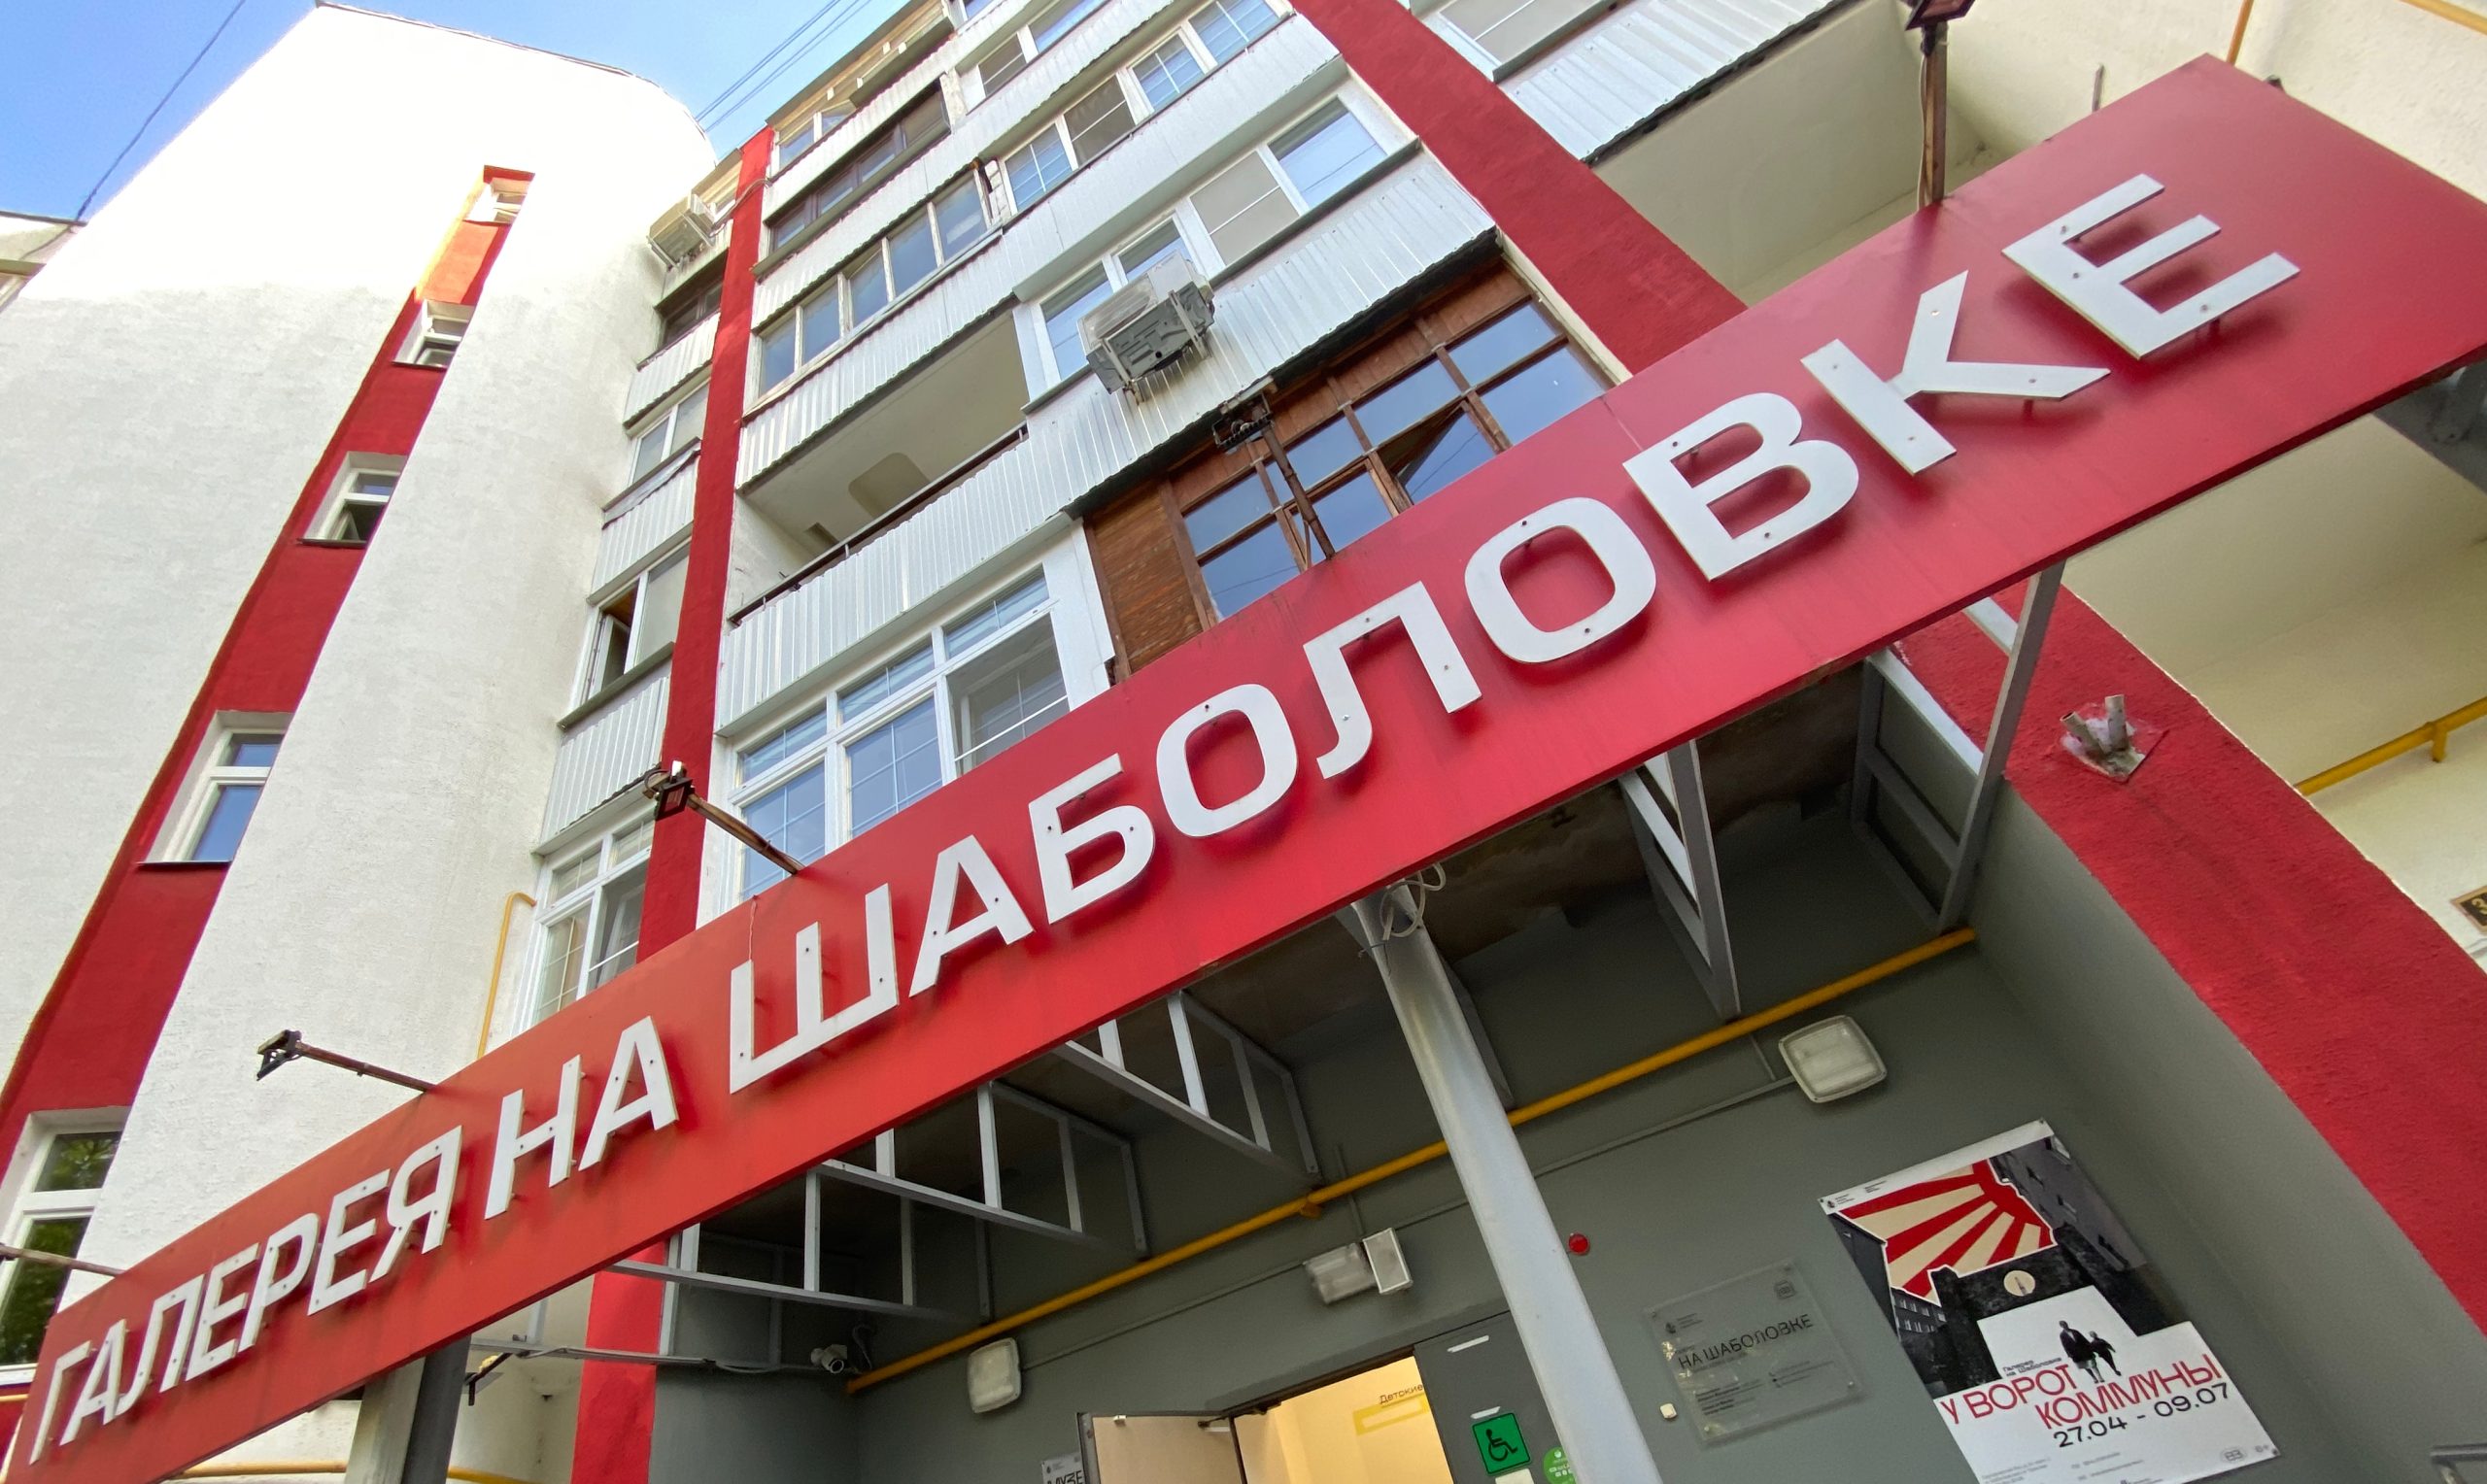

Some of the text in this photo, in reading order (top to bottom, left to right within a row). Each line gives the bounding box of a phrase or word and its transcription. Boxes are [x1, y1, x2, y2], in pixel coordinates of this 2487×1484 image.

[30, 173, 2300, 1466] ГАЛЕРЕЯ НА ШАБОЛОВКЕ
[1678, 1353, 1703, 1369] НА
[1703, 1314, 1814, 1361] ШАБОЛОВКЕ
[1380, 1384, 1423, 1405] Детские
[1940, 1364, 2077, 1425] У ВОРОТ
[2035, 1354, 2223, 1430] КОММУНЫ
[2053, 1416, 2128, 1448] 27.04
[2154, 1382, 2230, 1418] 09.07
